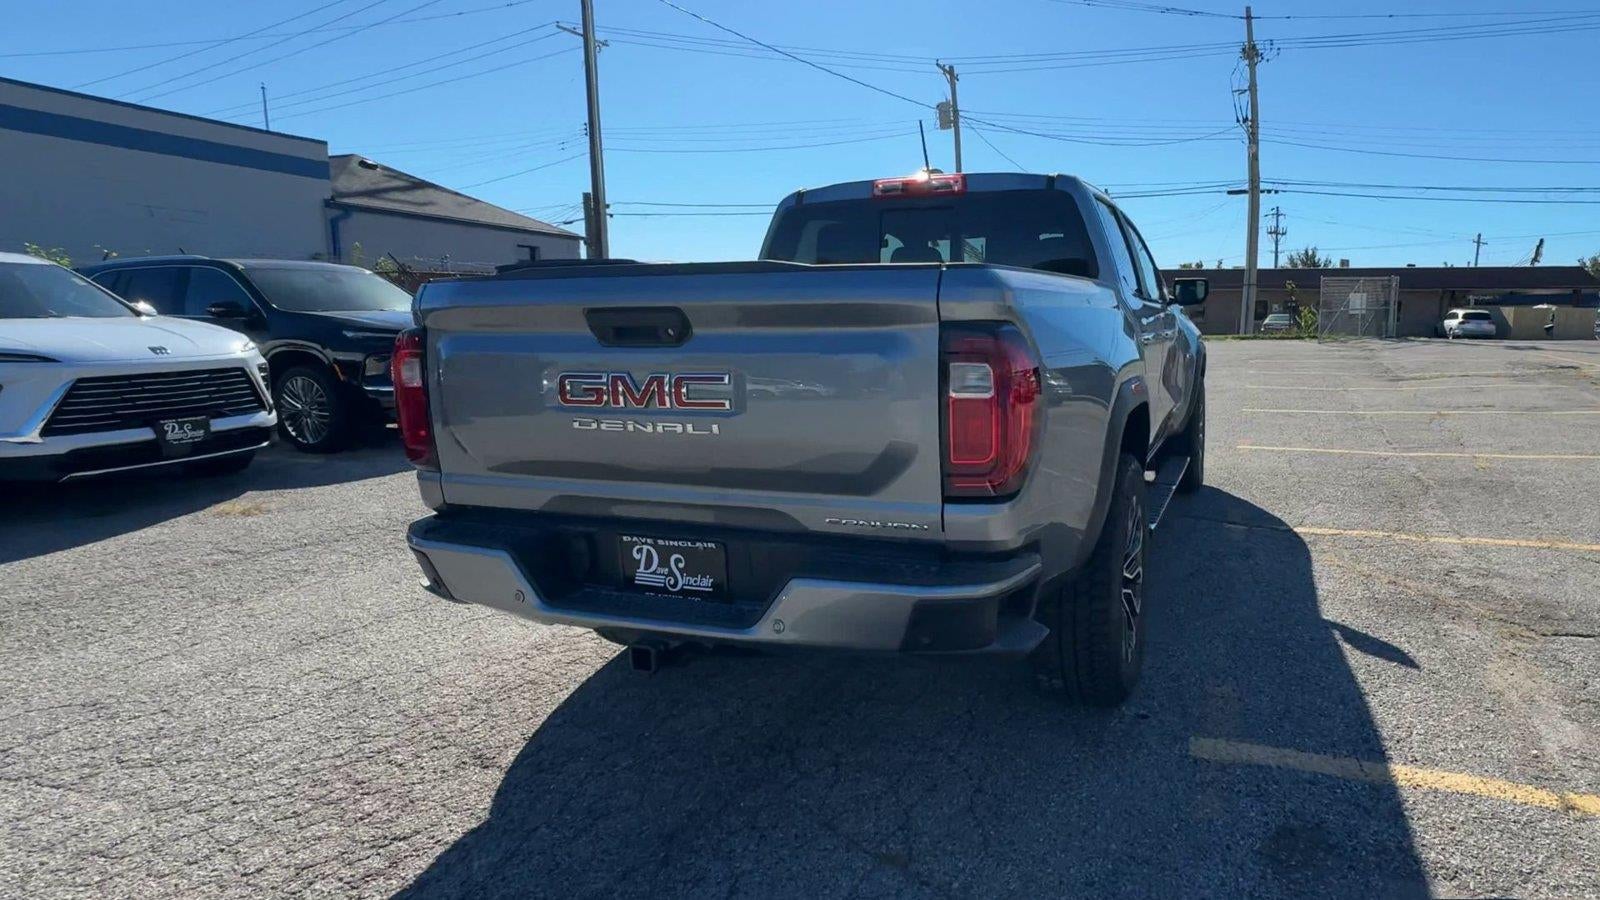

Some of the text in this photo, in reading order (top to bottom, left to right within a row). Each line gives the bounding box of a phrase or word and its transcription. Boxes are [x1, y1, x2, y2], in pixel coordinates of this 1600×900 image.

[558, 372, 731, 410] GMC
[572, 417, 720, 435] DENALI
[622, 535, 716, 549] DAVE SINCLAIR
[632, 545, 714, 591] Dave Sinclair
